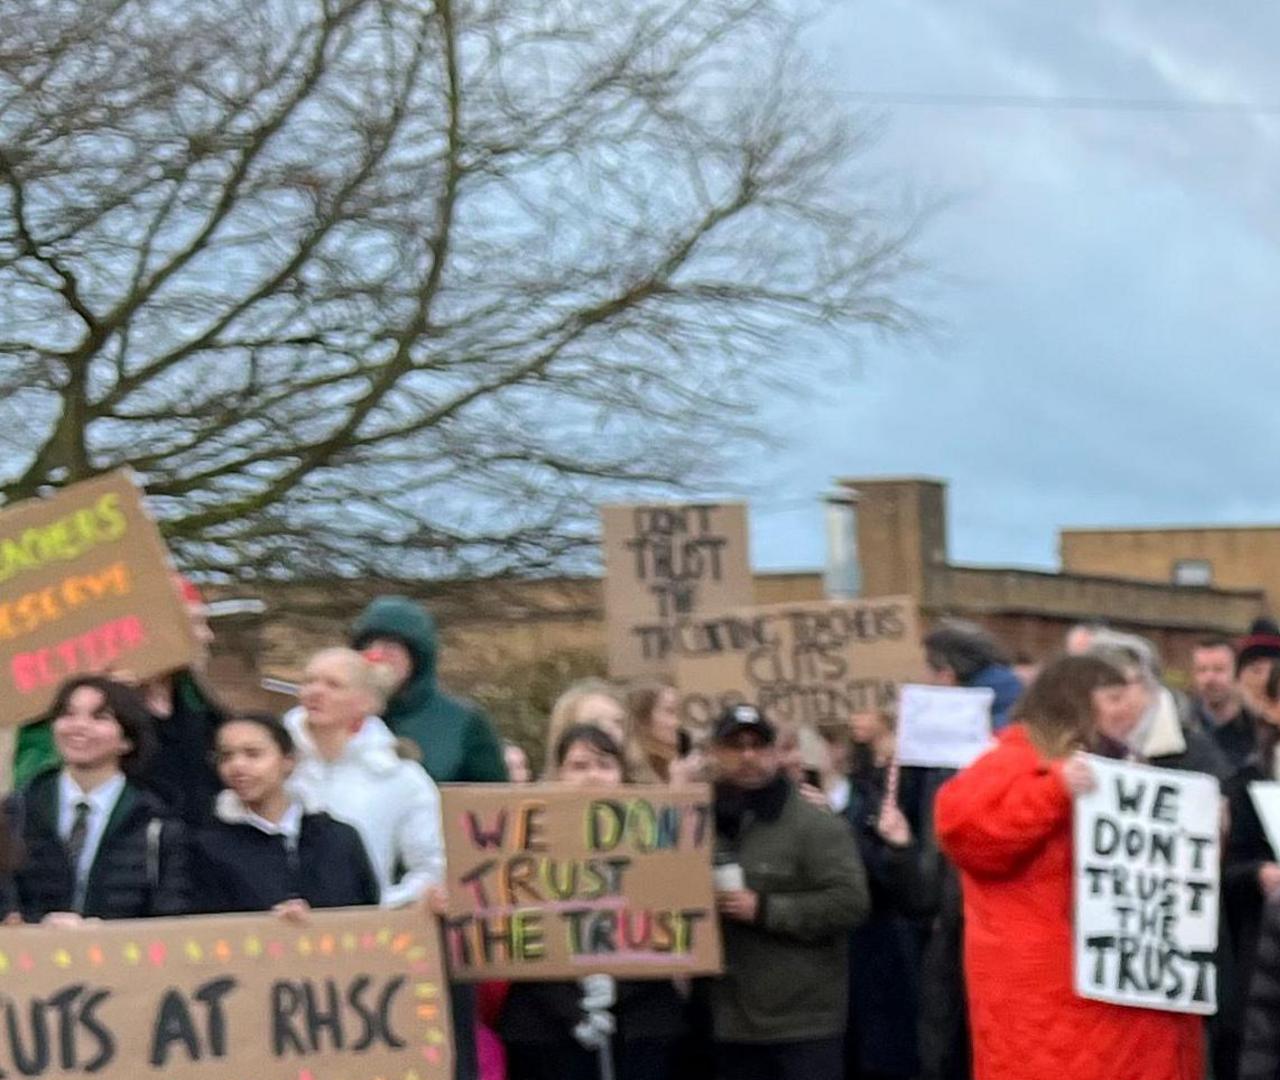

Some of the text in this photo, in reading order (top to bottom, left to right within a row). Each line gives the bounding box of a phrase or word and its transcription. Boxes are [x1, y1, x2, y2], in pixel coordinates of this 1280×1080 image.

[461, 799, 548, 851] WE
[1115, 777, 1180, 824] WE
[461, 854, 631, 911] TRUST
[1084, 865, 1213, 912] TRUST
[441, 905, 706, 966] THE TRUST
[1114, 905, 1178, 941] THE
[1085, 933, 1216, 1002] TRUST
[0, 973, 408, 1078] UTS AT RHSC
